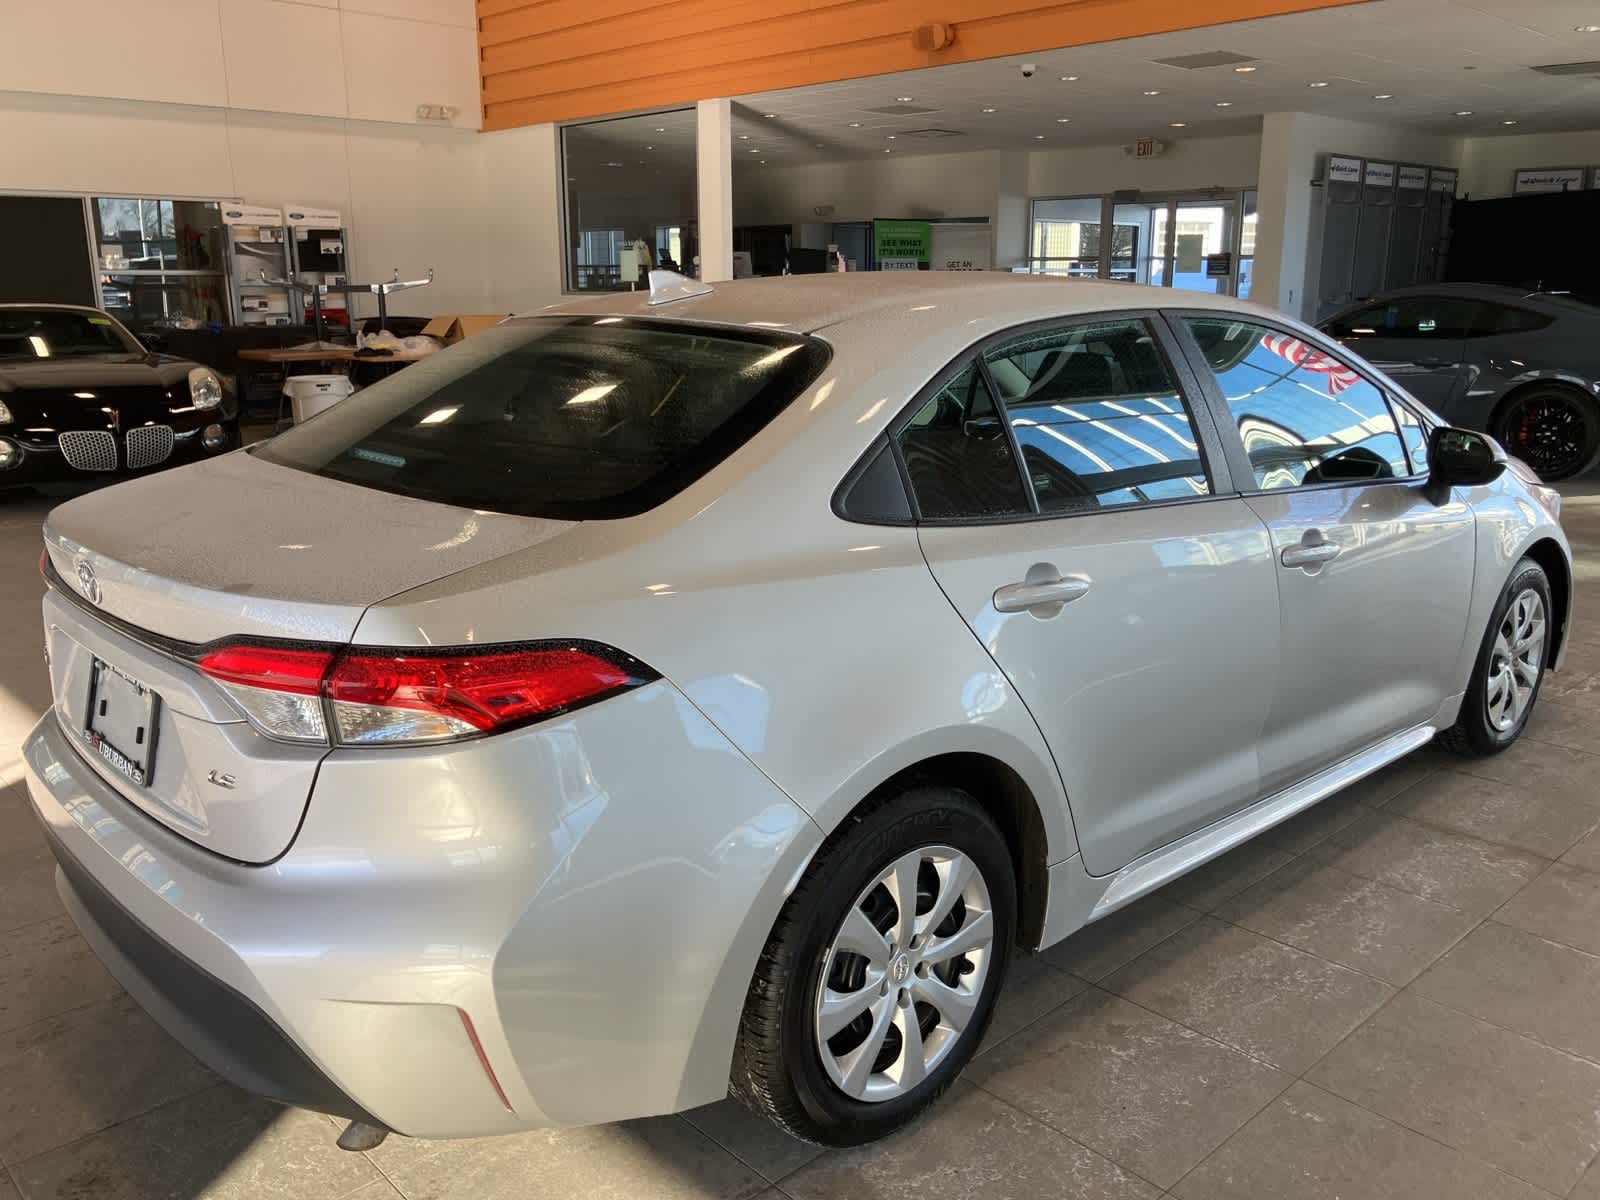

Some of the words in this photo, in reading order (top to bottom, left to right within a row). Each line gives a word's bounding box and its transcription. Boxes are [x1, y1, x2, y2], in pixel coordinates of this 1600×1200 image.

[1137, 141, 1153, 156] EXIT
[881, 239, 896, 247] SEE
[898, 239, 922, 247] WHAT
[896, 248, 925, 257] WORTH
[946, 260, 960, 268] GET
[962, 260, 972, 268] AN
[92, 735, 133, 777] SUBURBAN
[207, 768, 236, 790] LE
